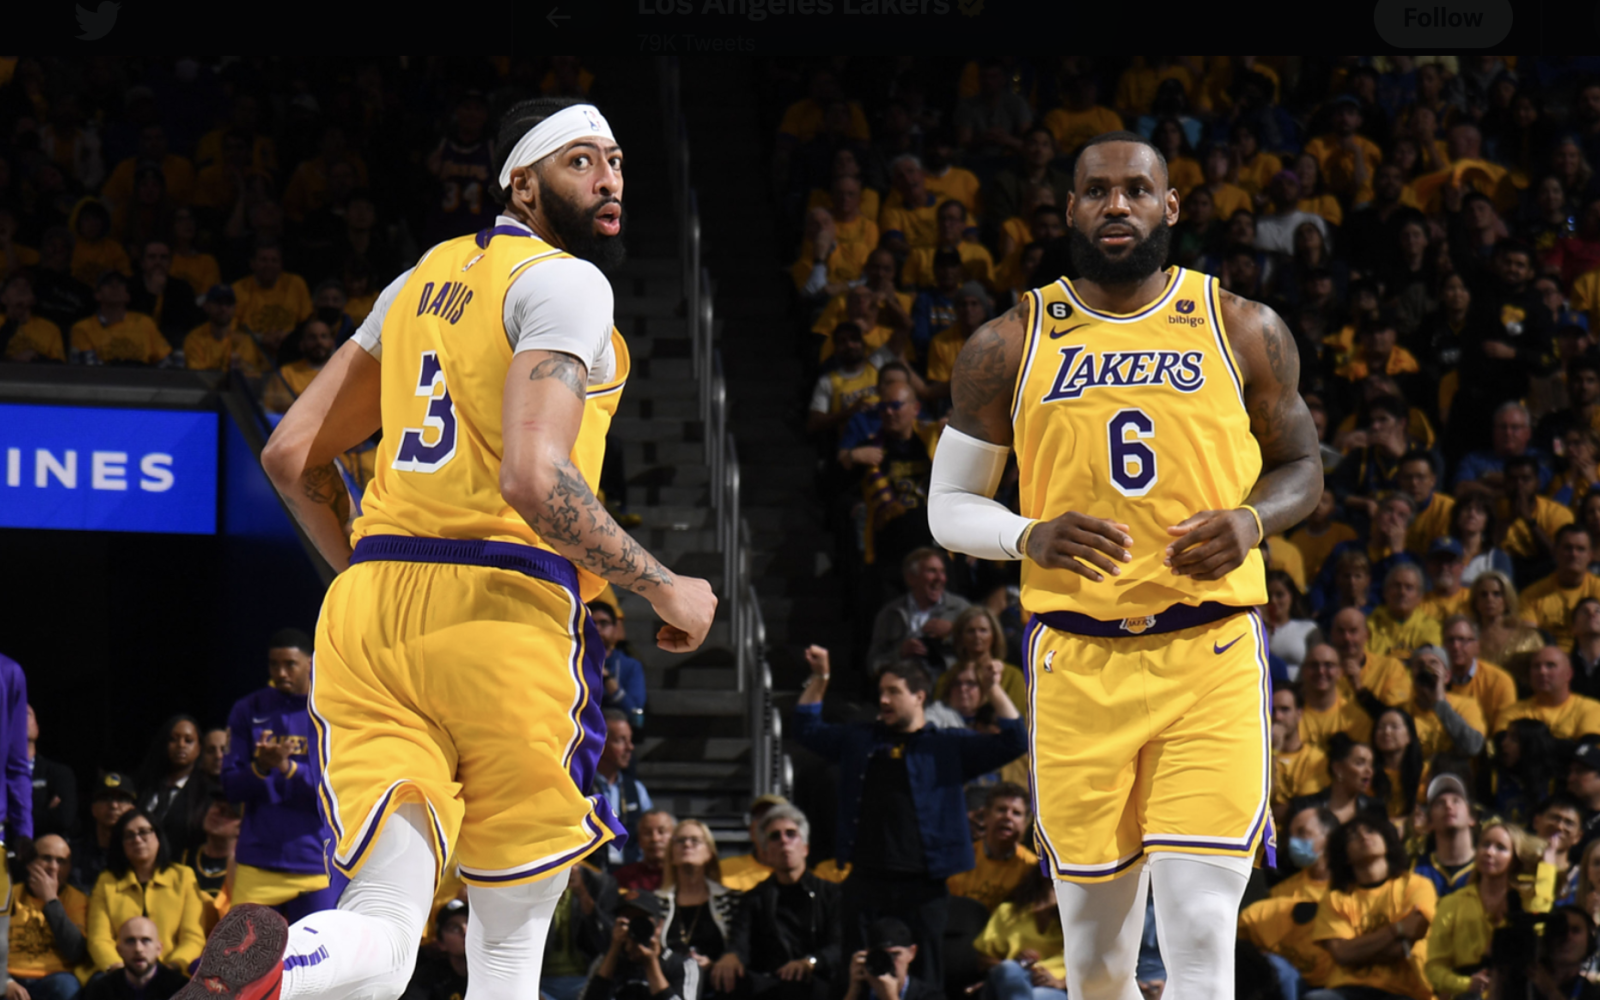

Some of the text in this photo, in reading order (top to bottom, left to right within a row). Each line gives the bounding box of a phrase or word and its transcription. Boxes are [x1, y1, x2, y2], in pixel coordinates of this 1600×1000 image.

[417, 281, 474, 325] DAVIS
[1052, 303, 1066, 318] 6
[1168, 315, 1205, 327] bibigo
[1040, 344, 1206, 404] LAKERS
[390, 349, 458, 474] 3
[7, 447, 175, 493] INES
[1106, 408, 1158, 497] 6
